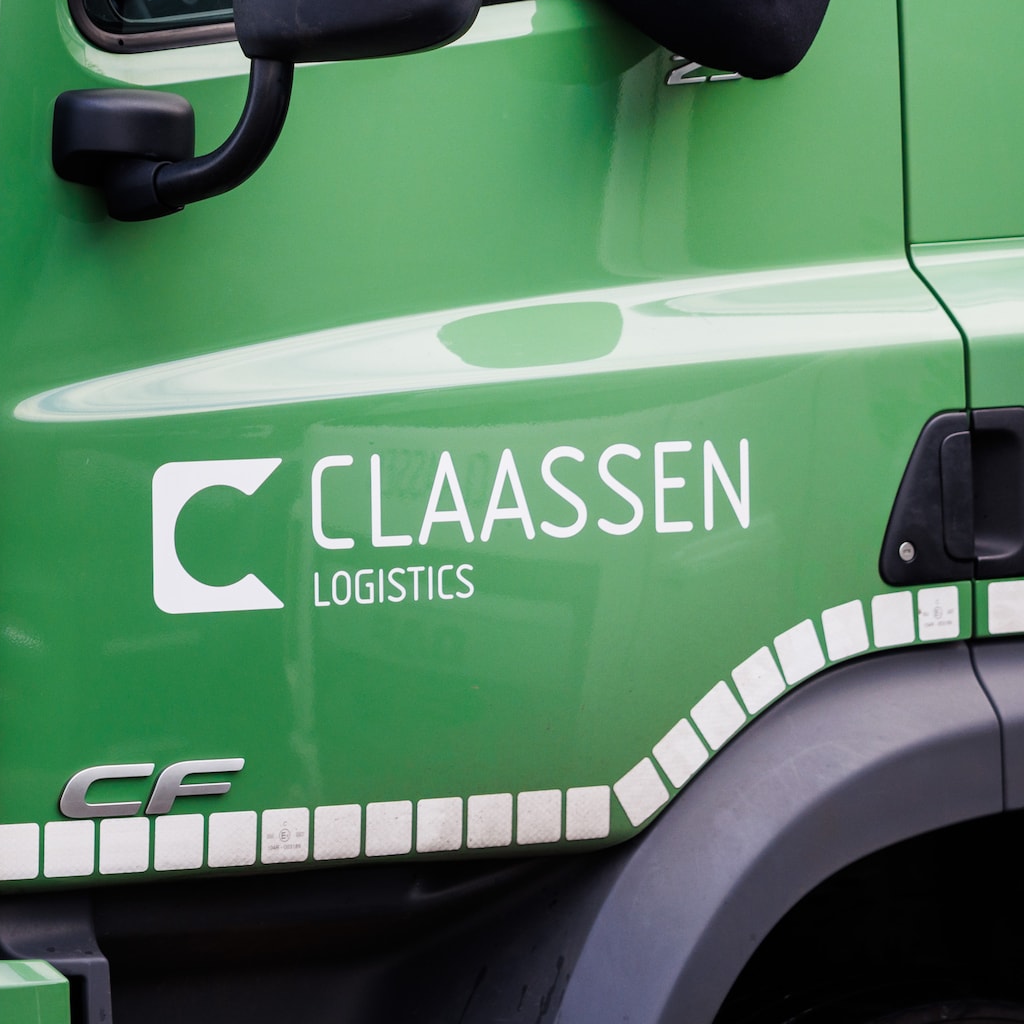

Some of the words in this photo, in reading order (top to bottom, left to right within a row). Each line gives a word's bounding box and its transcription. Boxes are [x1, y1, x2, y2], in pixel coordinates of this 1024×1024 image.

[311, 438, 750, 550] CLAASSEN
[314, 563, 475, 607] LOGISTICS
[59, 757, 245, 820] CF
